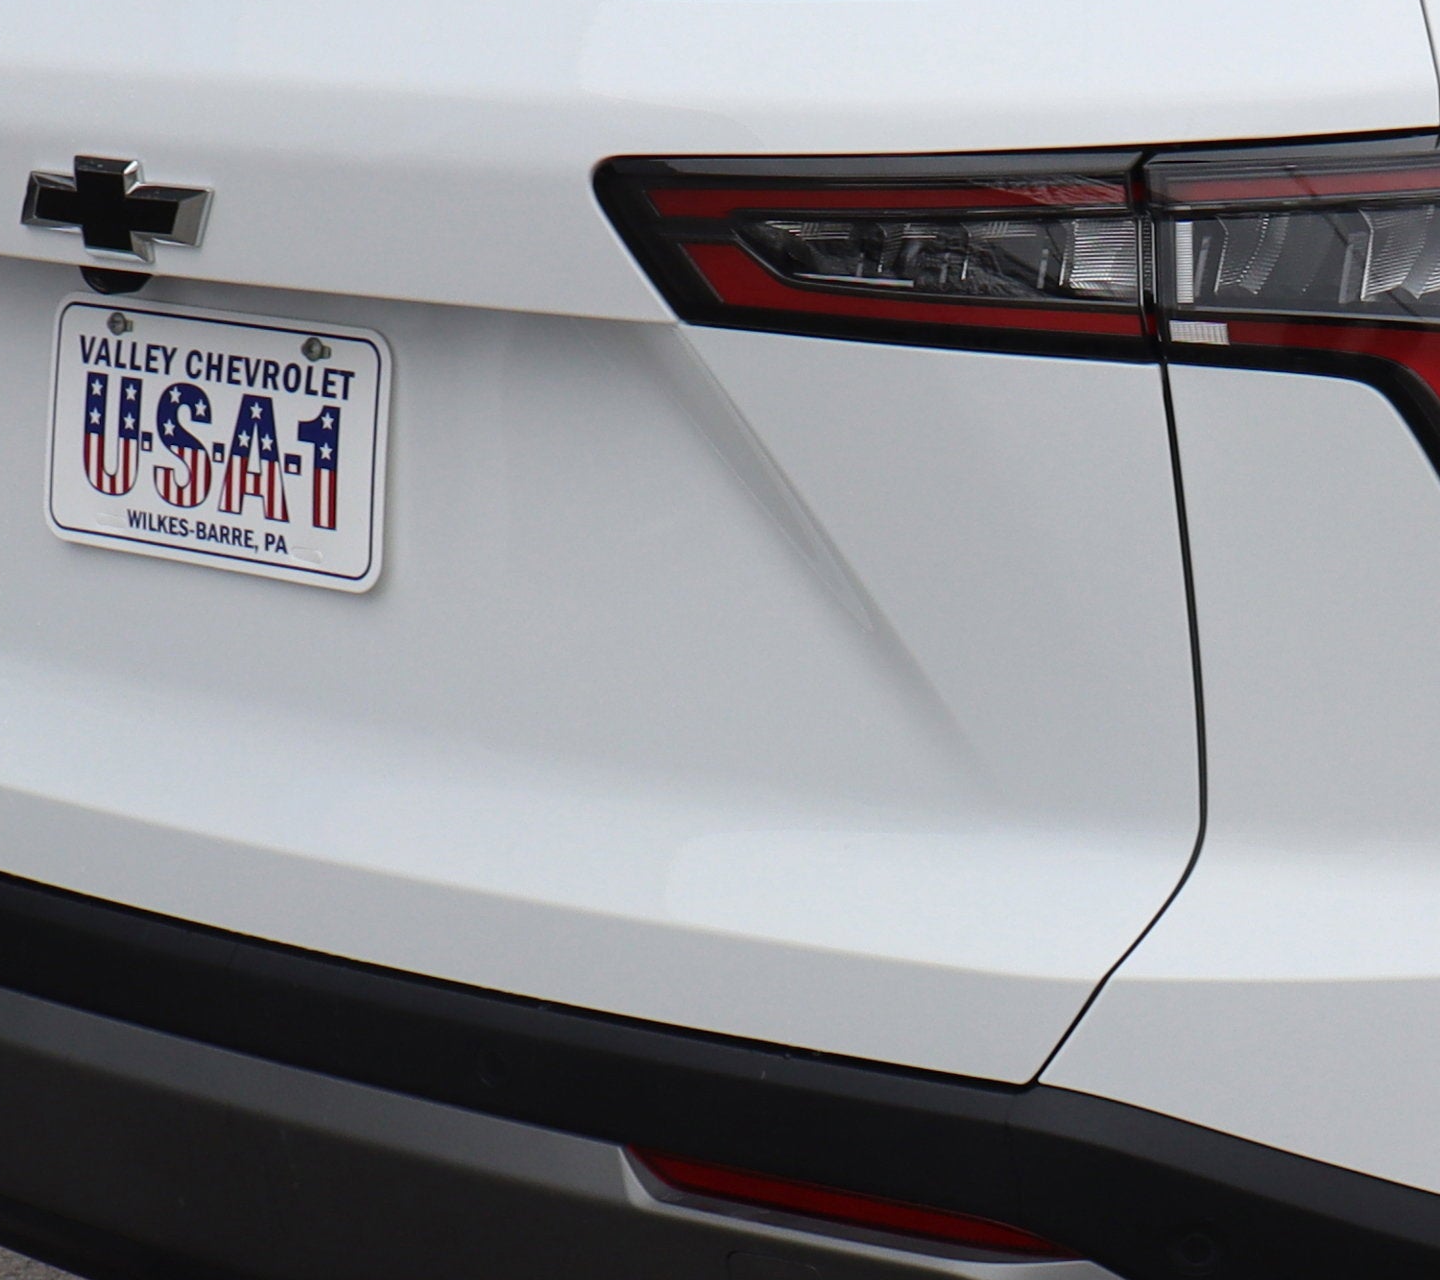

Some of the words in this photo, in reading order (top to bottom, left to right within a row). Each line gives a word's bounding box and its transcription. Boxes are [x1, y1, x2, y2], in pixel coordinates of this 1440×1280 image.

[79, 334, 178, 376] VALLEY
[185, 349, 356, 401] CHEVROLET
[126, 508, 259, 554] WILKES-BARRE,
[264, 532, 289, 555] PA
